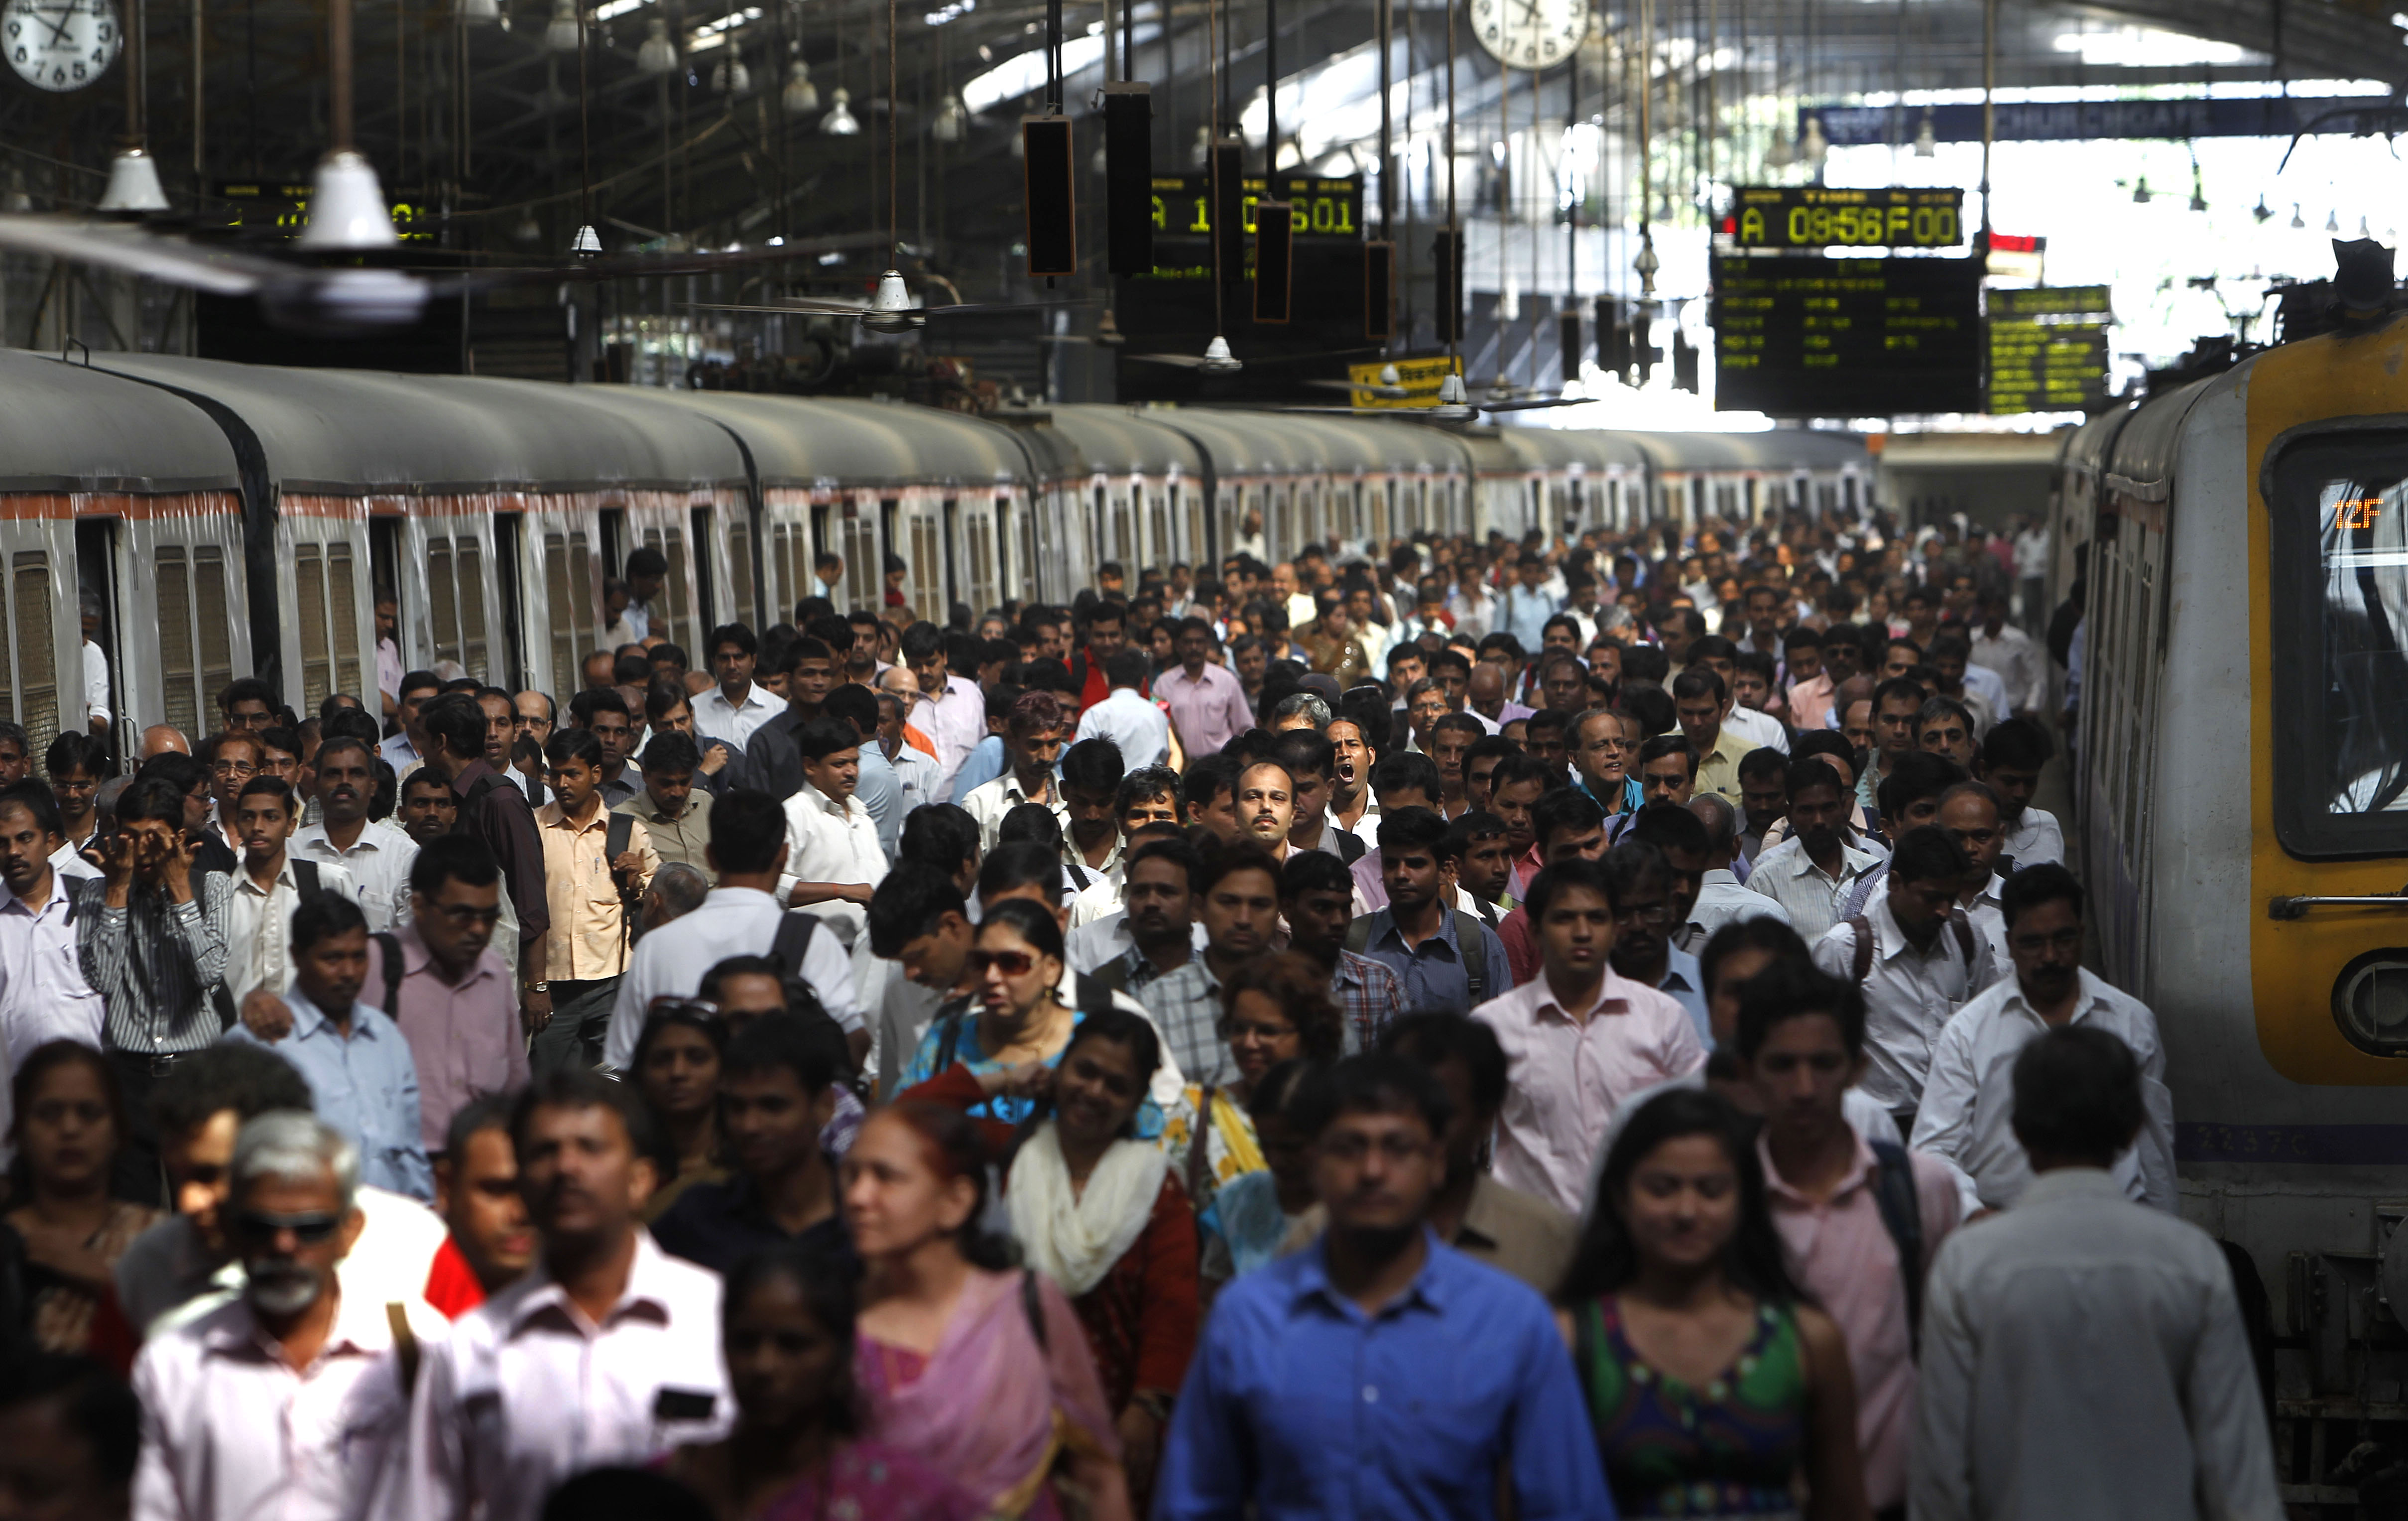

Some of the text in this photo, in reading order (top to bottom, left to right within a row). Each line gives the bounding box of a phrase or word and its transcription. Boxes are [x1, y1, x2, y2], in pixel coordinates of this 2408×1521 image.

[8, 20, 21, 38] 9
[98, 23, 112, 42] 3
[1486, 23, 1498, 40] 8
[1562, 25, 1574, 39] 4
[15, 45, 27, 62] 8
[91, 47, 103, 63] 4
[1504, 37, 1517, 55] 7
[1544, 37, 1558, 55] 5
[33, 60, 47, 79] 7
[53, 65, 65, 85] 6
[72, 60, 87, 80] 5
[1741, 206, 1765, 244] A
[2331, 499, 2385, 529] 12F
